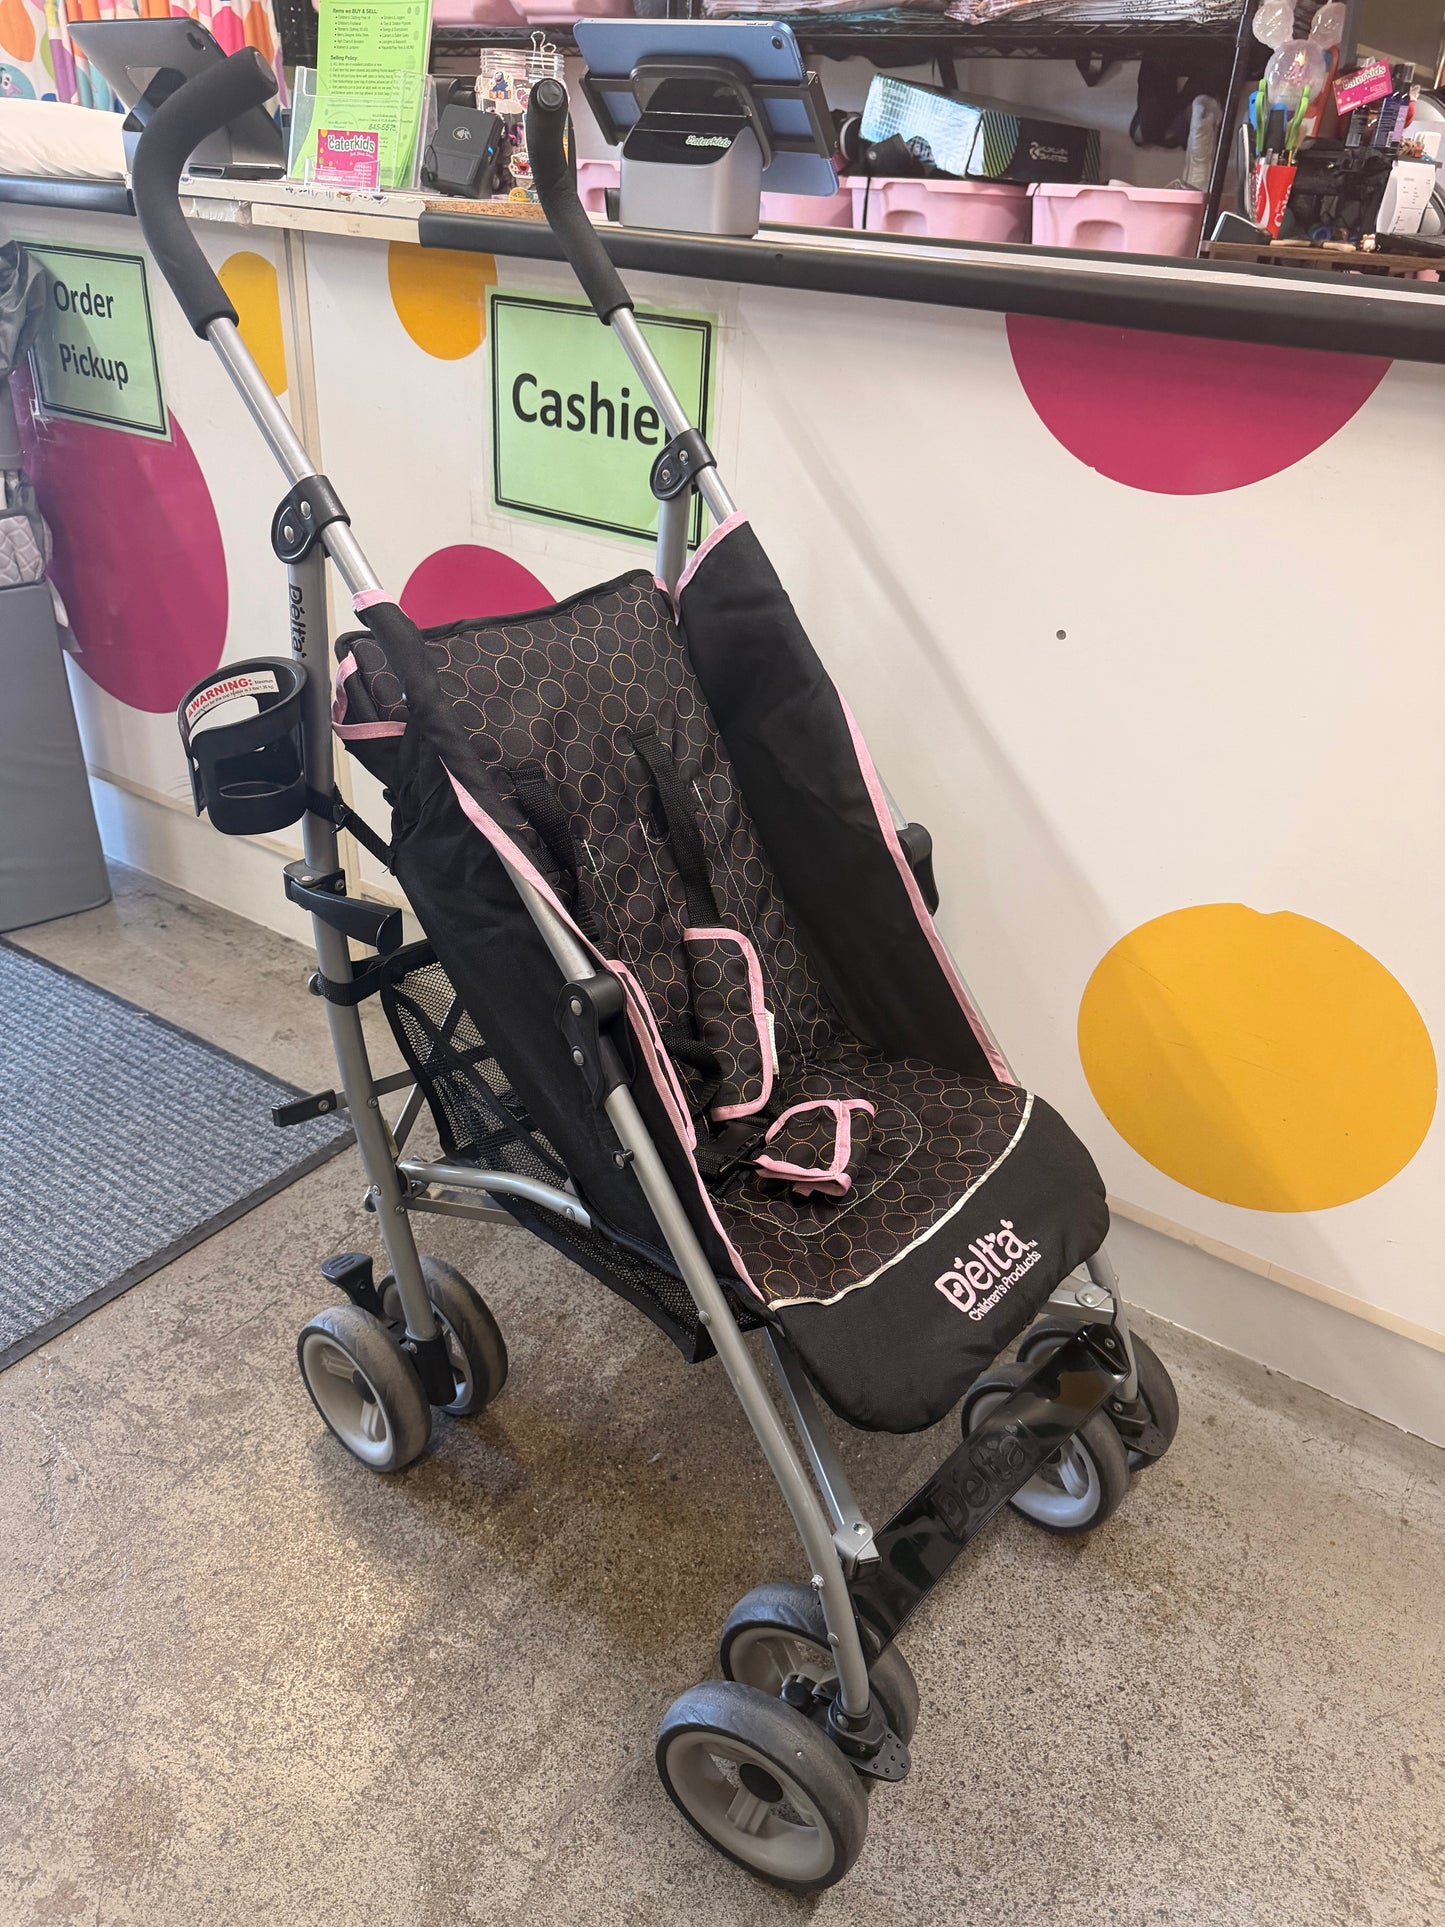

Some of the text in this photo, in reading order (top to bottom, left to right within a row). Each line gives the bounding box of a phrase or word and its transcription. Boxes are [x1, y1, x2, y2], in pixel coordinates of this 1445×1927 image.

[53, 280, 114, 319] Order
[59, 343, 129, 390] Pickup
[289, 584, 307, 653] Delta
[191, 678, 253, 711] WARNING:
[934, 1223, 1030, 1313] Delta
[968, 1250, 1041, 1320] Children's Products
[932, 1432, 1026, 1539] Delta
